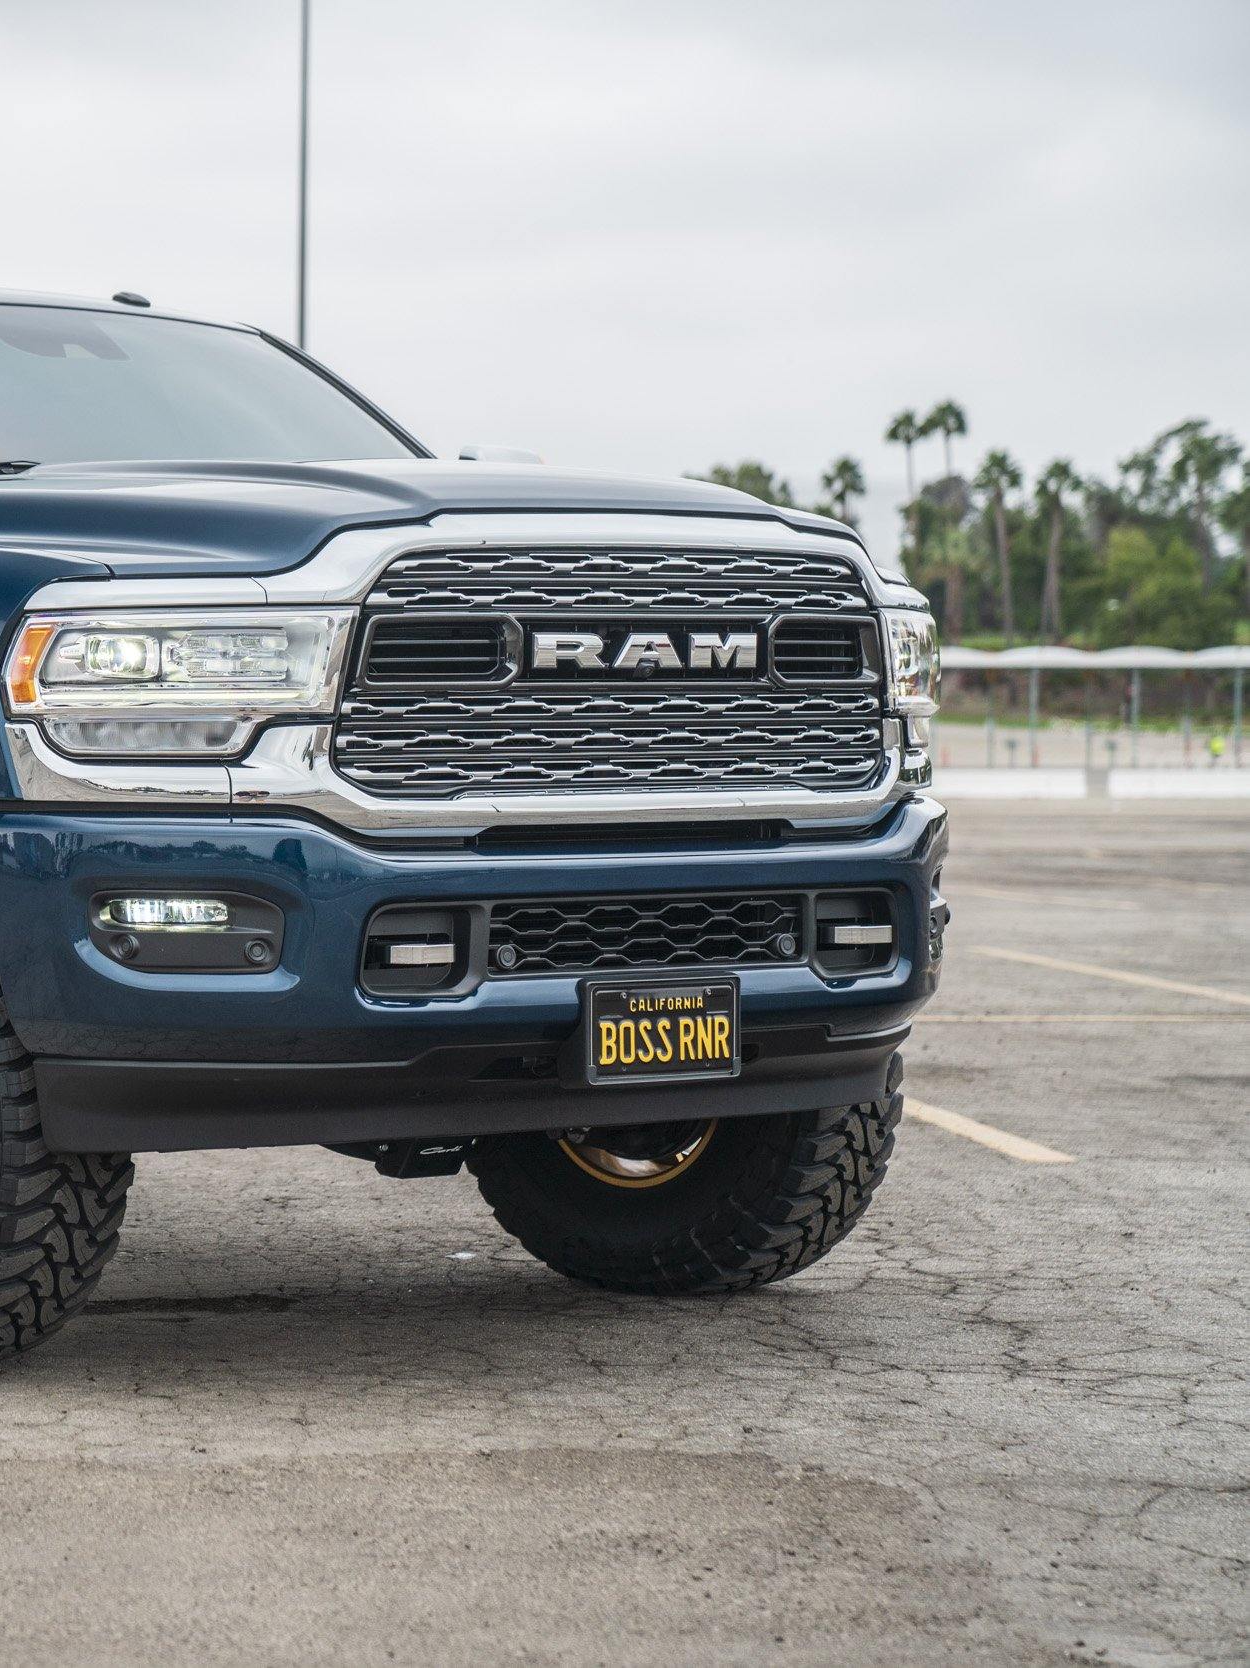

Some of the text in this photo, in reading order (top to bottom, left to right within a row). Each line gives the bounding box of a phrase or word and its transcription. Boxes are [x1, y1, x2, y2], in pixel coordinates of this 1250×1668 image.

[531, 632, 758, 669] RAM
[629, 996, 704, 1013] CALIFORNIA
[599, 1015, 731, 1066] BOSS RNR
